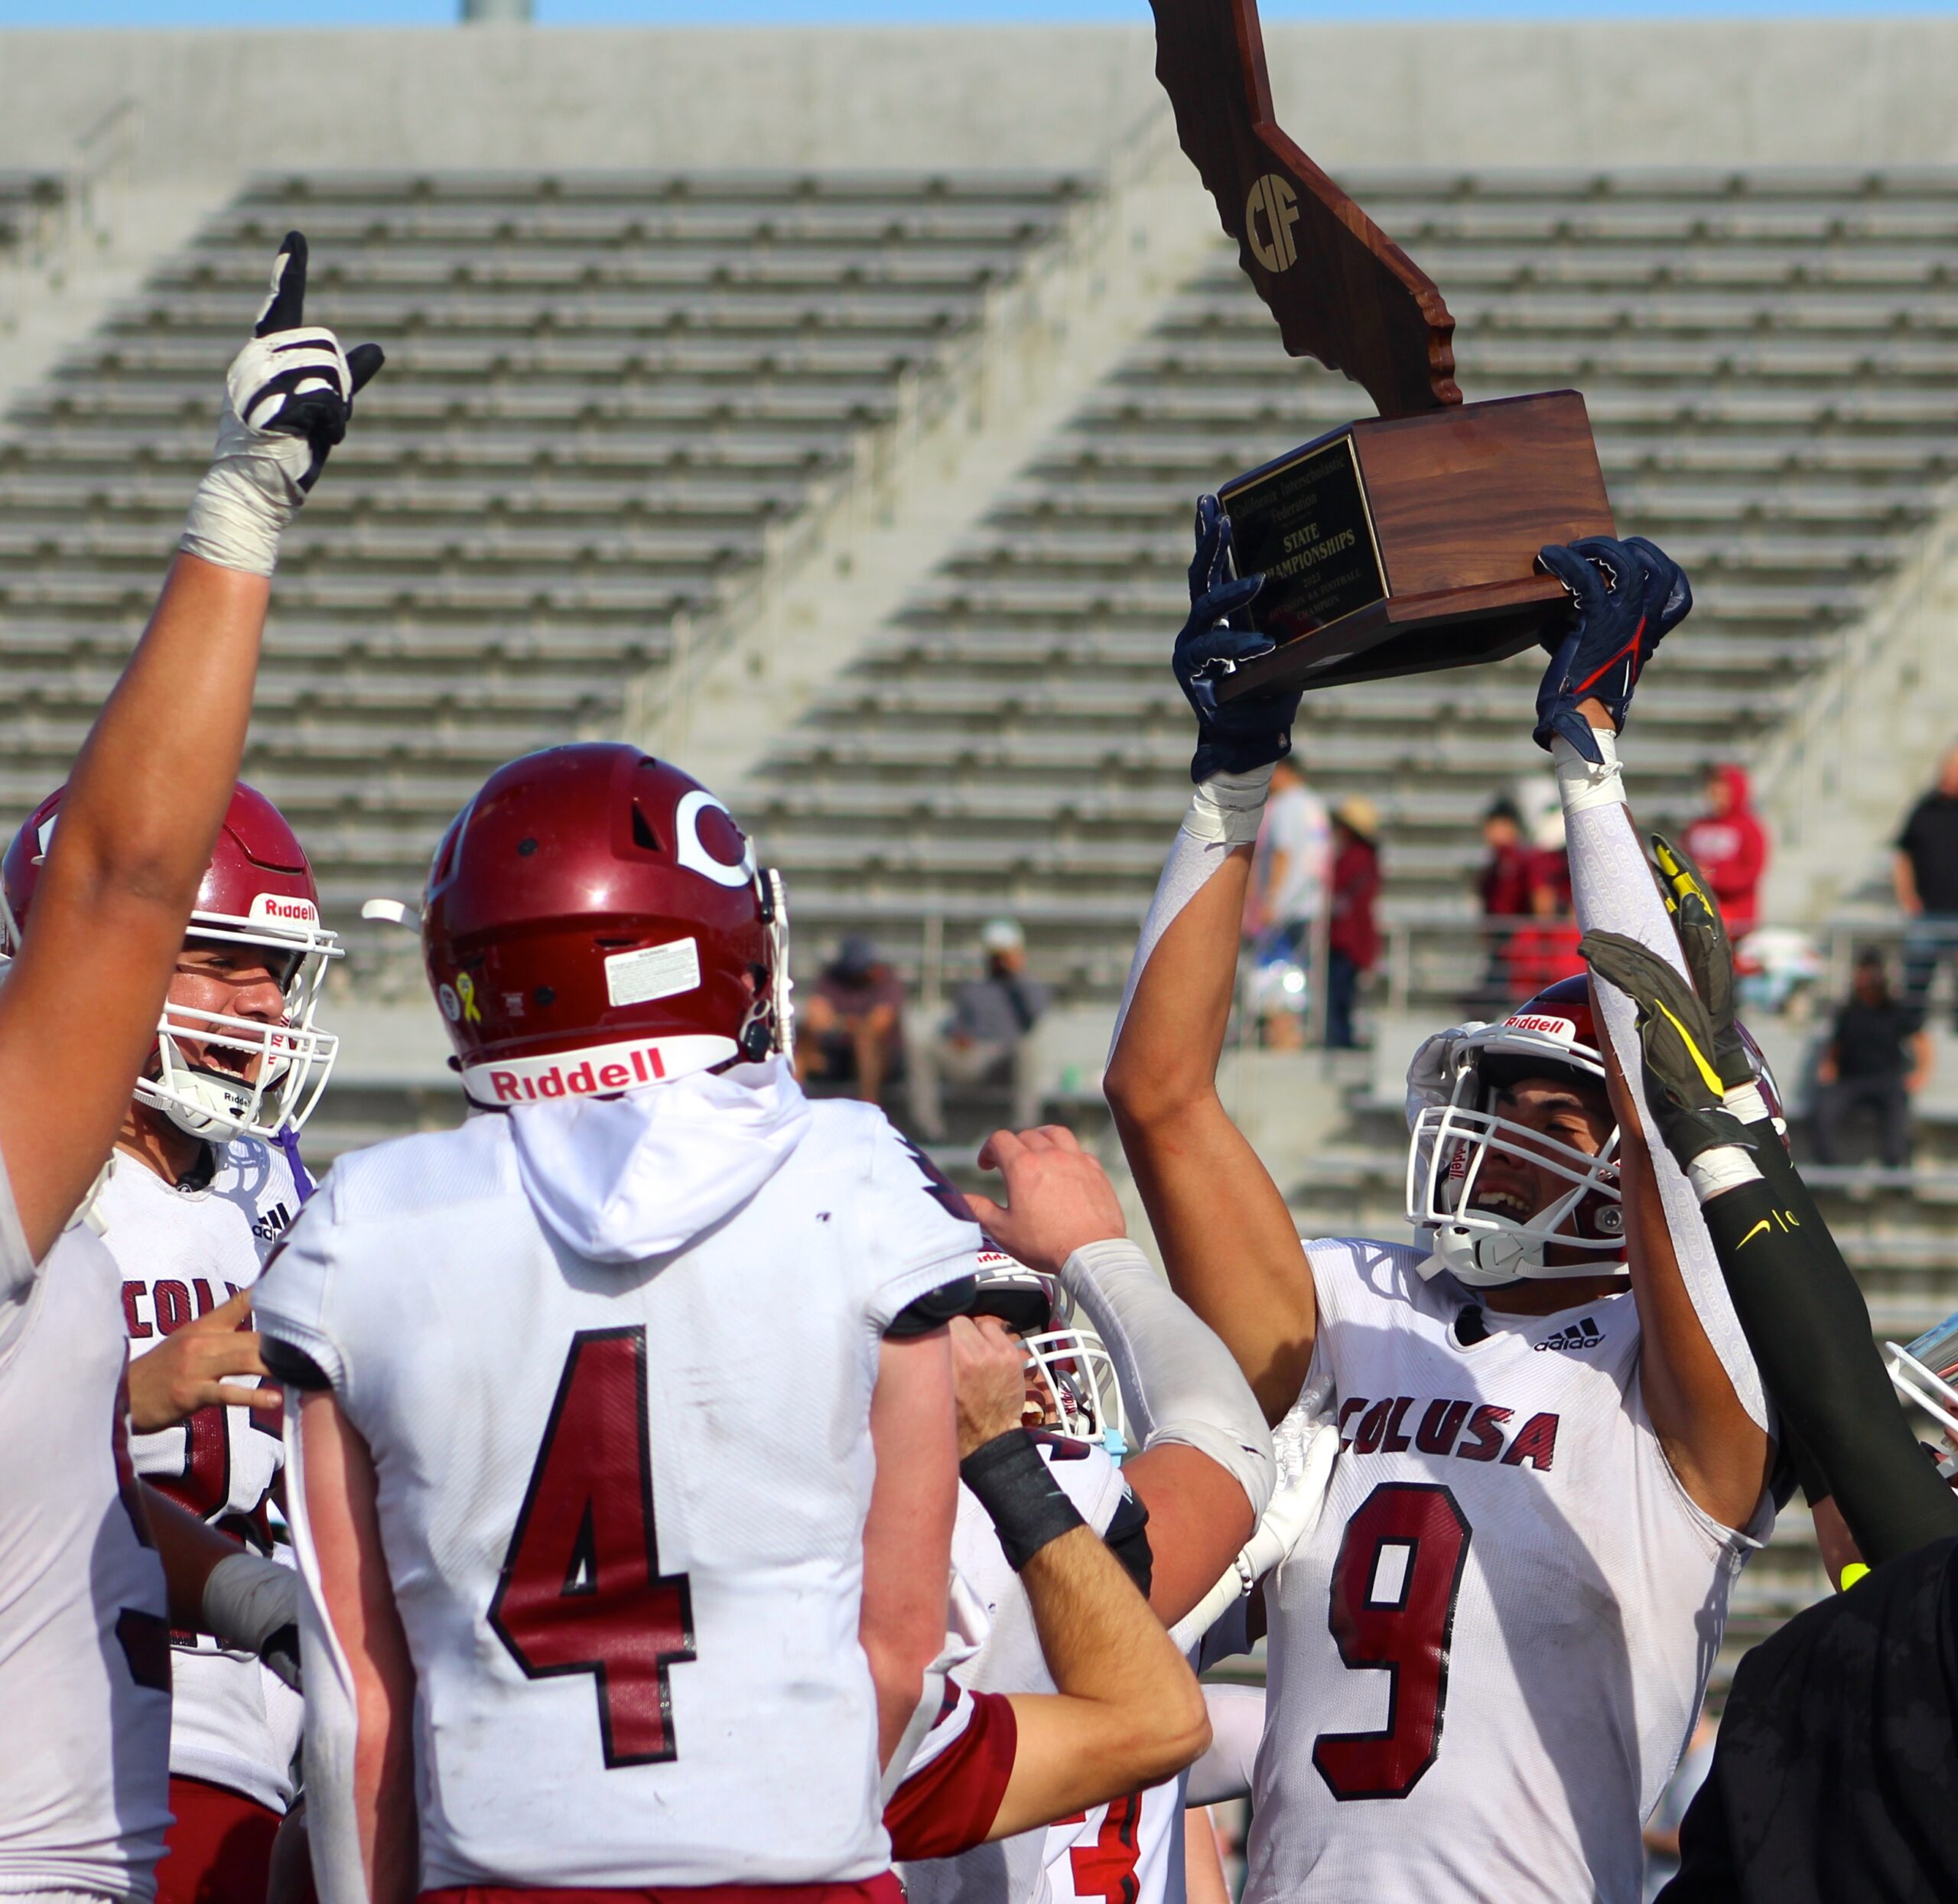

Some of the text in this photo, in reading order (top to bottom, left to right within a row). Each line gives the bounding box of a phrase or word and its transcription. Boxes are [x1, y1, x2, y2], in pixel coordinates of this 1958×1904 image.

[1246, 174, 1299, 272] CIF
[1233, 489, 1278, 519] California
[1280, 455, 1346, 497] Interscholastic
[1271, 492, 1317, 523] Federation
[1266, 529, 1356, 581] HAMPIONSHIPS
[1283, 522, 1319, 553] STATE
[1297, 594, 1340, 622] CHAMPION
[265, 899, 315, 921] Riddell
[1505, 1016, 1565, 1033] Riddell
[490, 1047, 665, 1102] Riddell
[1339, 1396, 1560, 1473] COLUSA
[486, 1324, 697, 1769] 4
[1312, 1481, 1473, 1801] 9
